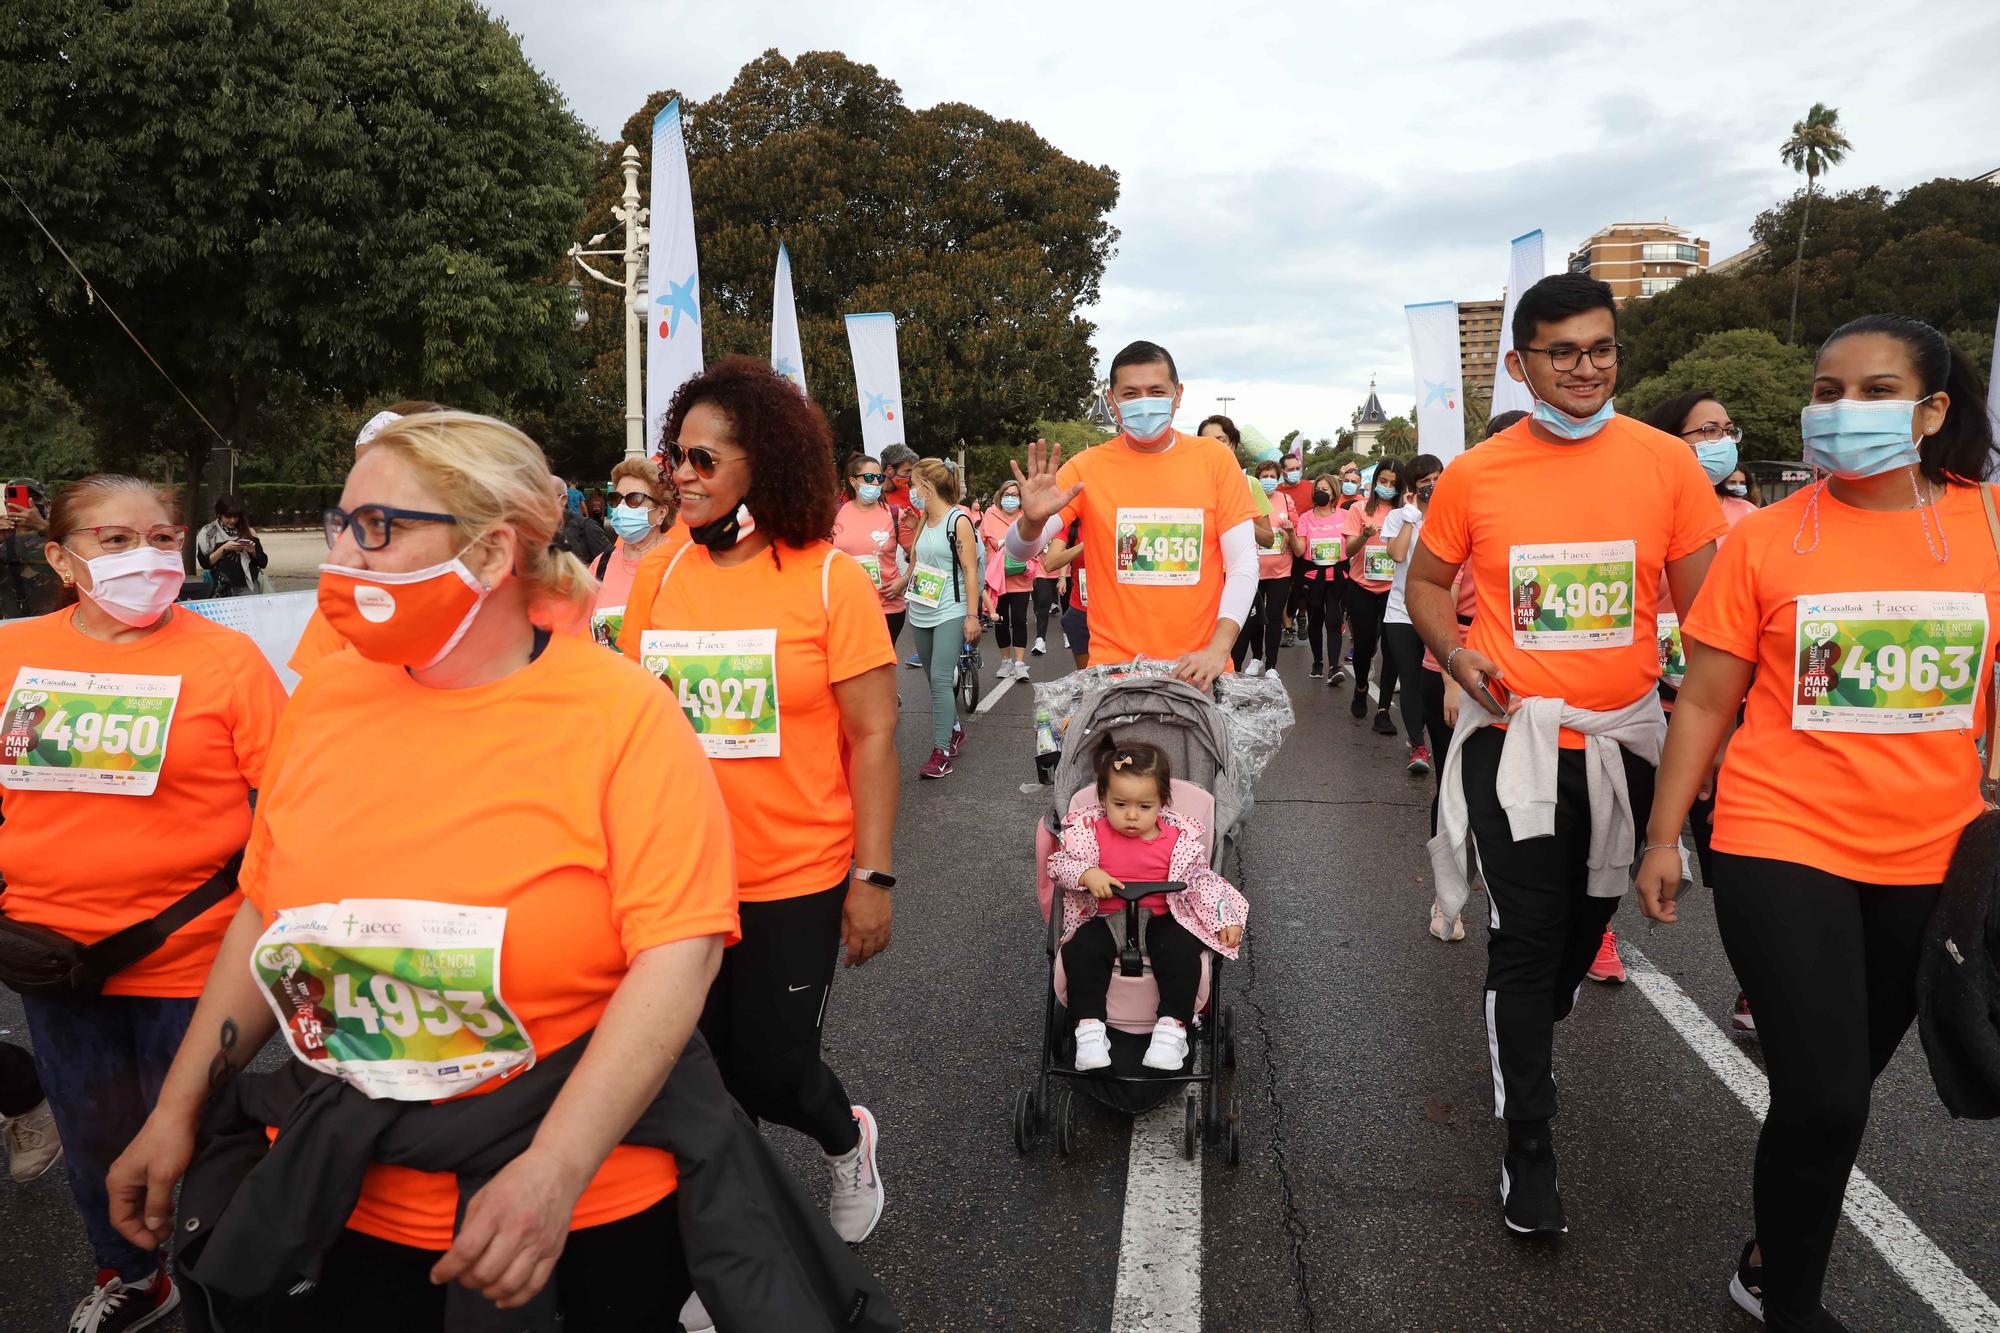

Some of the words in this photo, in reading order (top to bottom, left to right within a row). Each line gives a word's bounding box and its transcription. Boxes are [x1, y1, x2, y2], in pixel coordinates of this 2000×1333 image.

[1138, 536, 1198, 562] 4936
[918, 579, 939, 595] 595
[1542, 581, 1628, 618] 4962
[1517, 608, 1534, 617] MAR
[1823, 604, 1864, 612] CaixaBank
[1887, 603, 1918, 612] aecc
[1518, 617, 1535, 625] CHA
[1808, 659, 1820, 675] RUN
[1841, 644, 1975, 692] 4963
[41, 678, 78, 688] CaixaBank
[1804, 676, 1829, 687] MAR
[679, 677, 767, 719] 4927
[1804, 687, 1828, 697] CHA
[41, 711, 160, 756] 4950
[6, 735, 29, 747] MAR
[5, 747, 29, 758] CHA
[360, 923, 401, 934] aecc
[334, 973, 504, 1038] 4953
